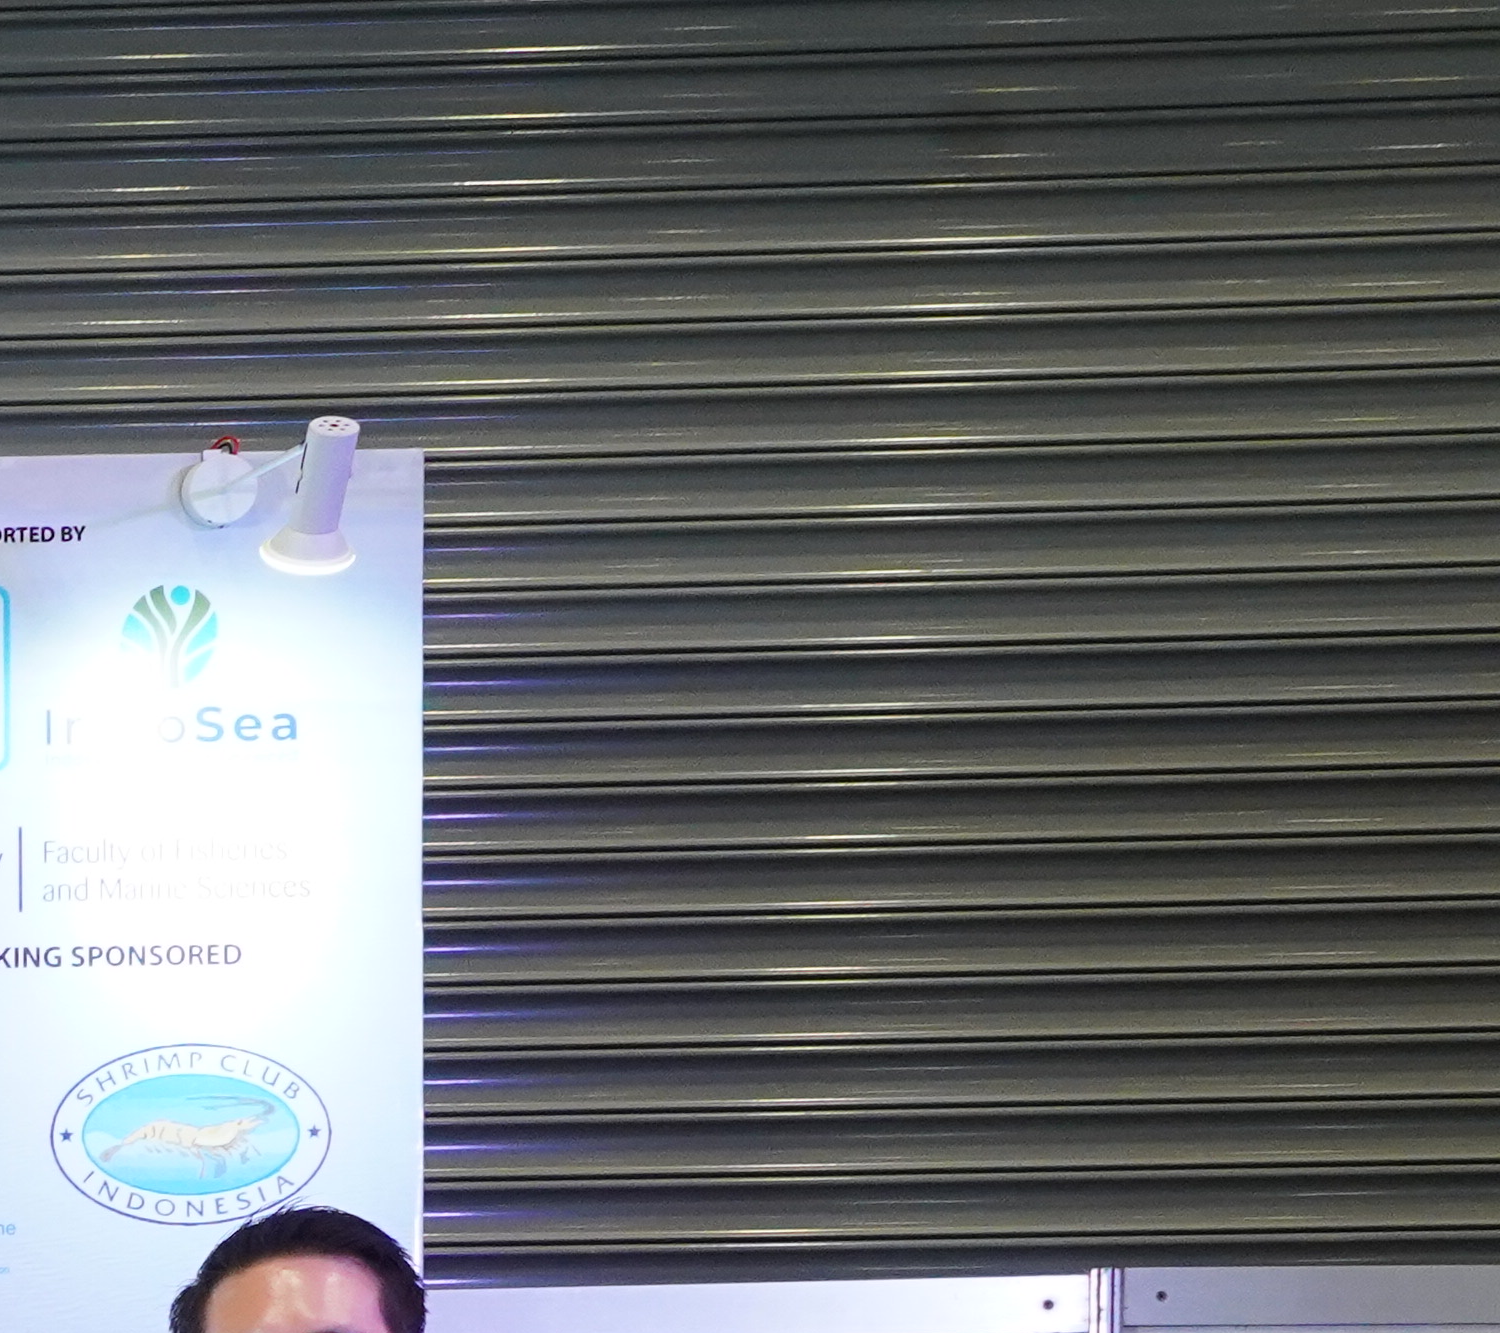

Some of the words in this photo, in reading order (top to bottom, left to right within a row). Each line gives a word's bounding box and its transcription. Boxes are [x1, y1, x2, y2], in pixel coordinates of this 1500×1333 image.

[61, 525, 86, 543] BY
[43, 877, 88, 902] and
[70, 943, 243, 969] SPONSORED
[76, 1052, 203, 1107] SHRIMP
[221, 1054, 301, 1100] CLUB
[83, 1170, 295, 1218] INDONESIA
